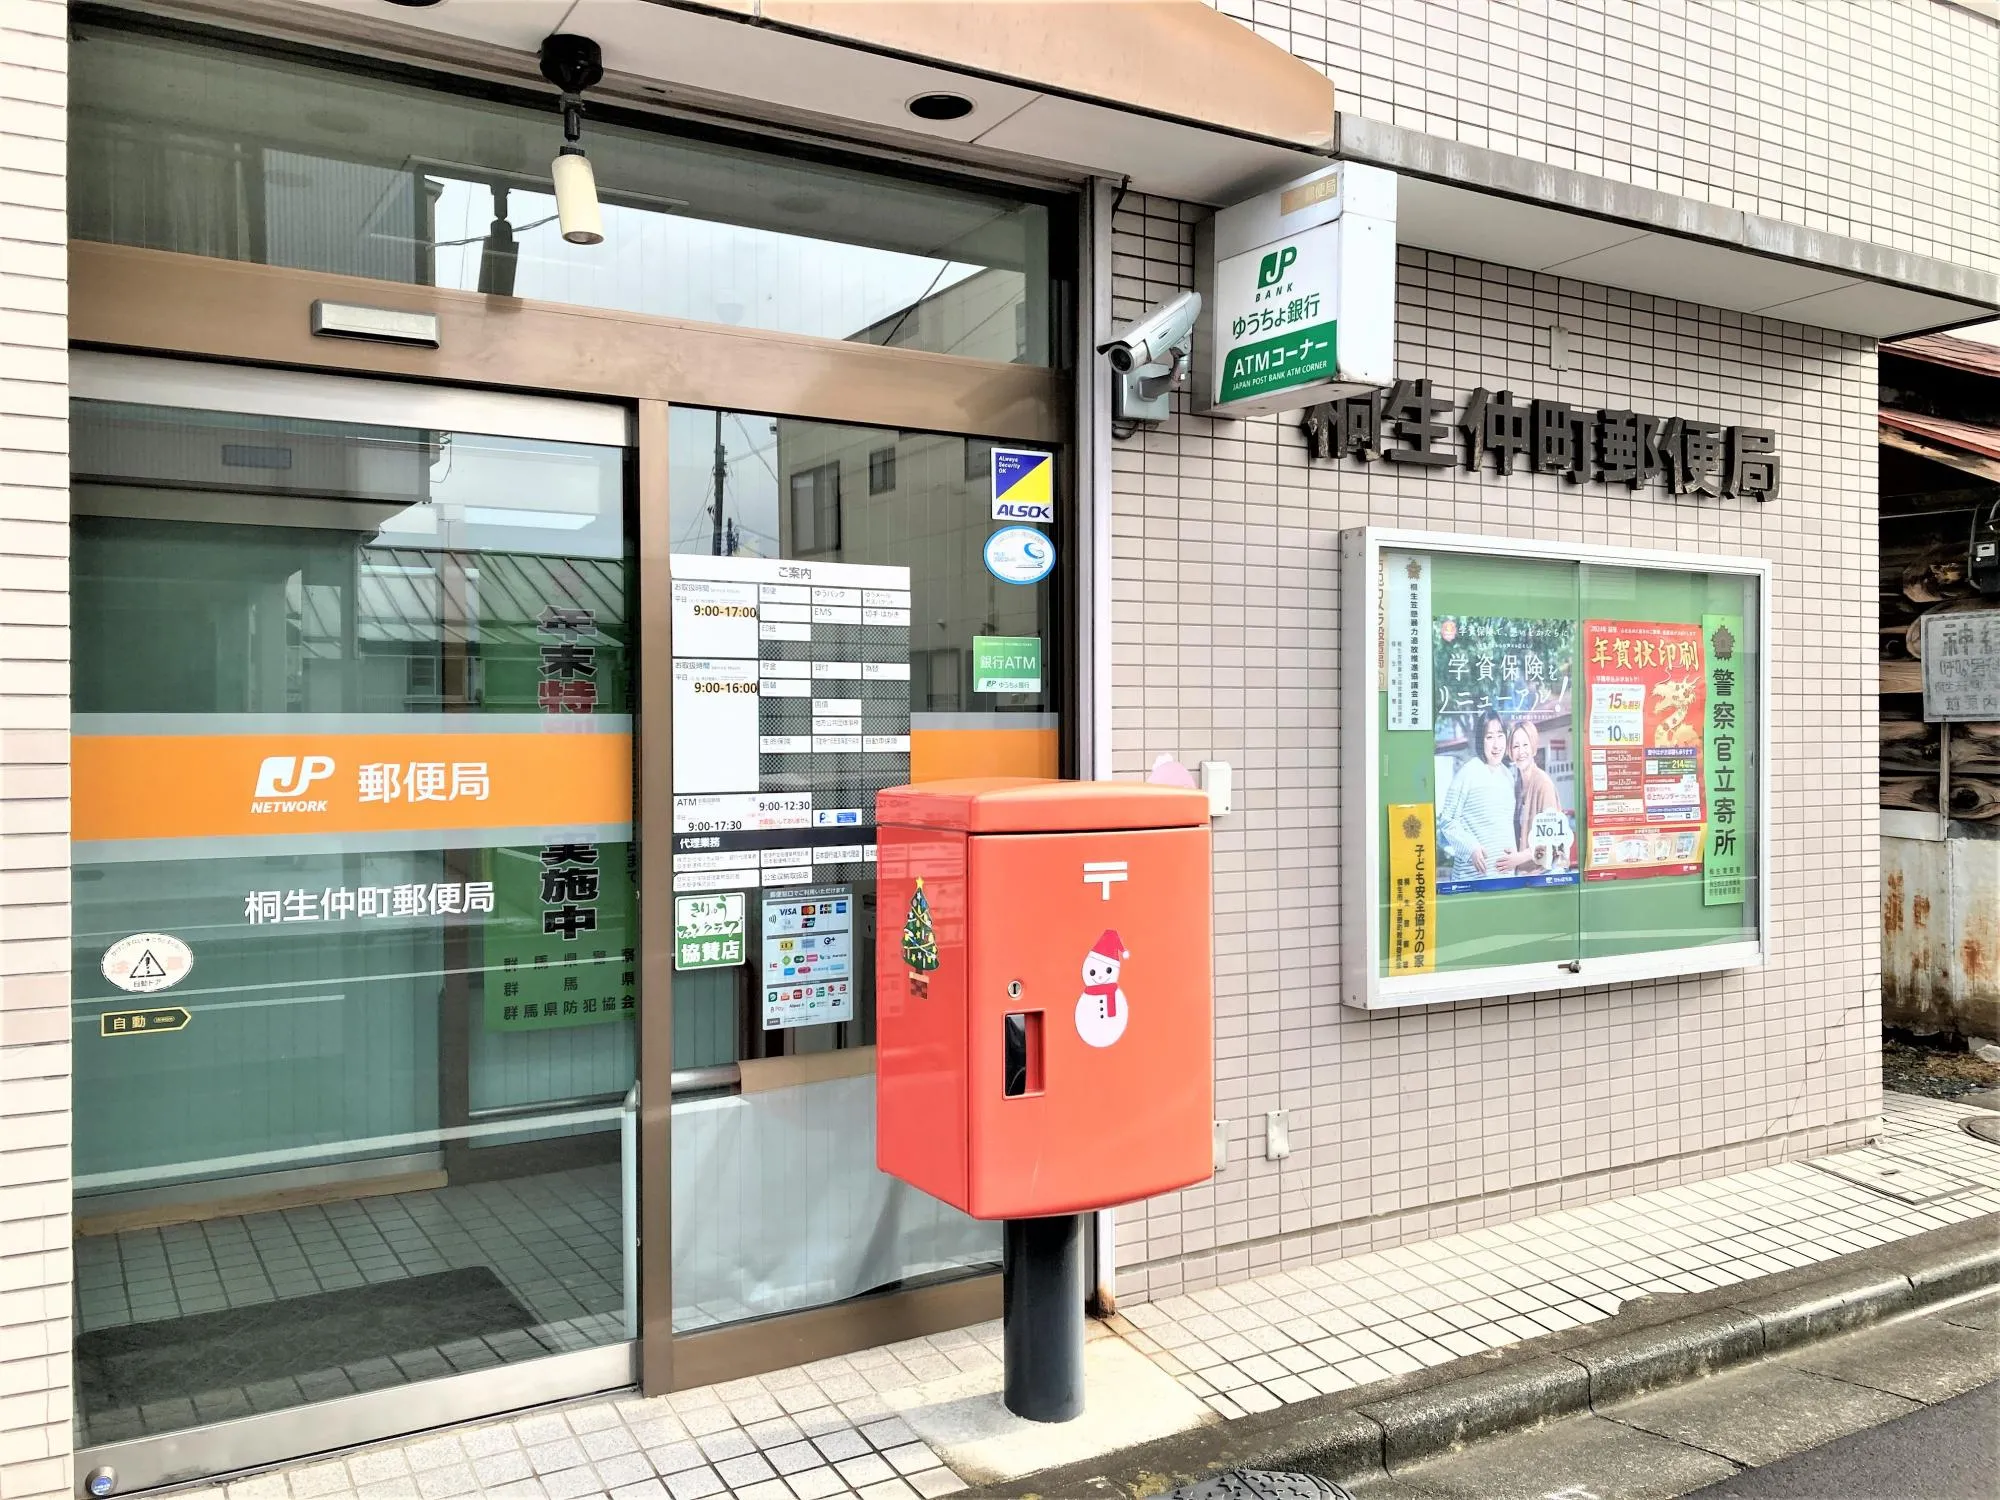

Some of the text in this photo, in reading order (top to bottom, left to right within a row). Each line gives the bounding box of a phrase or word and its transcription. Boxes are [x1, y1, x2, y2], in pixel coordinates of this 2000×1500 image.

[1255, 282, 1293, 303] BANK
[1232, 292, 1321, 340] ゆうちょ銀行
[1233, 338, 1329, 378] ATMコーナー
[1232, 359, 1328, 391] JAPAN POST BANK ATM CORNER
[1302, 378, 1781, 503] 桐生仲町郵便局
[996, 503, 1050, 519] ALSOK
[778, 566, 812, 580] ご案内
[693, 604, 757, 618] 9:00-17:00
[814, 608, 833, 616] EMS
[980, 655, 1036, 670] 銀行ATM
[1591, 636, 1699, 672] 年賀状印刷
[1448, 653, 1559, 681] 学資保険を
[694, 681, 758, 694] 9:00-16:00
[1712, 668, 1736, 859] 警察官立寄所
[357, 761, 490, 804] 郵便局
[250, 799, 329, 814] NETWORK
[677, 798, 696, 807] ATM
[759, 801, 811, 812] 9:00-12:30
[688, 820, 742, 832] 9:00-17:30
[679, 837, 720, 849] 代理業務
[244, 881, 496, 925] 桐生仲町郵便局
[780, 908, 797, 916] VISA
[1414, 844, 1425, 968] 子ども安全協力の家
[681, 940, 741, 964] 協賛店
[503, 994, 635, 1021] 群馬県防犯協会
[113, 1015, 147, 1031] 自動
